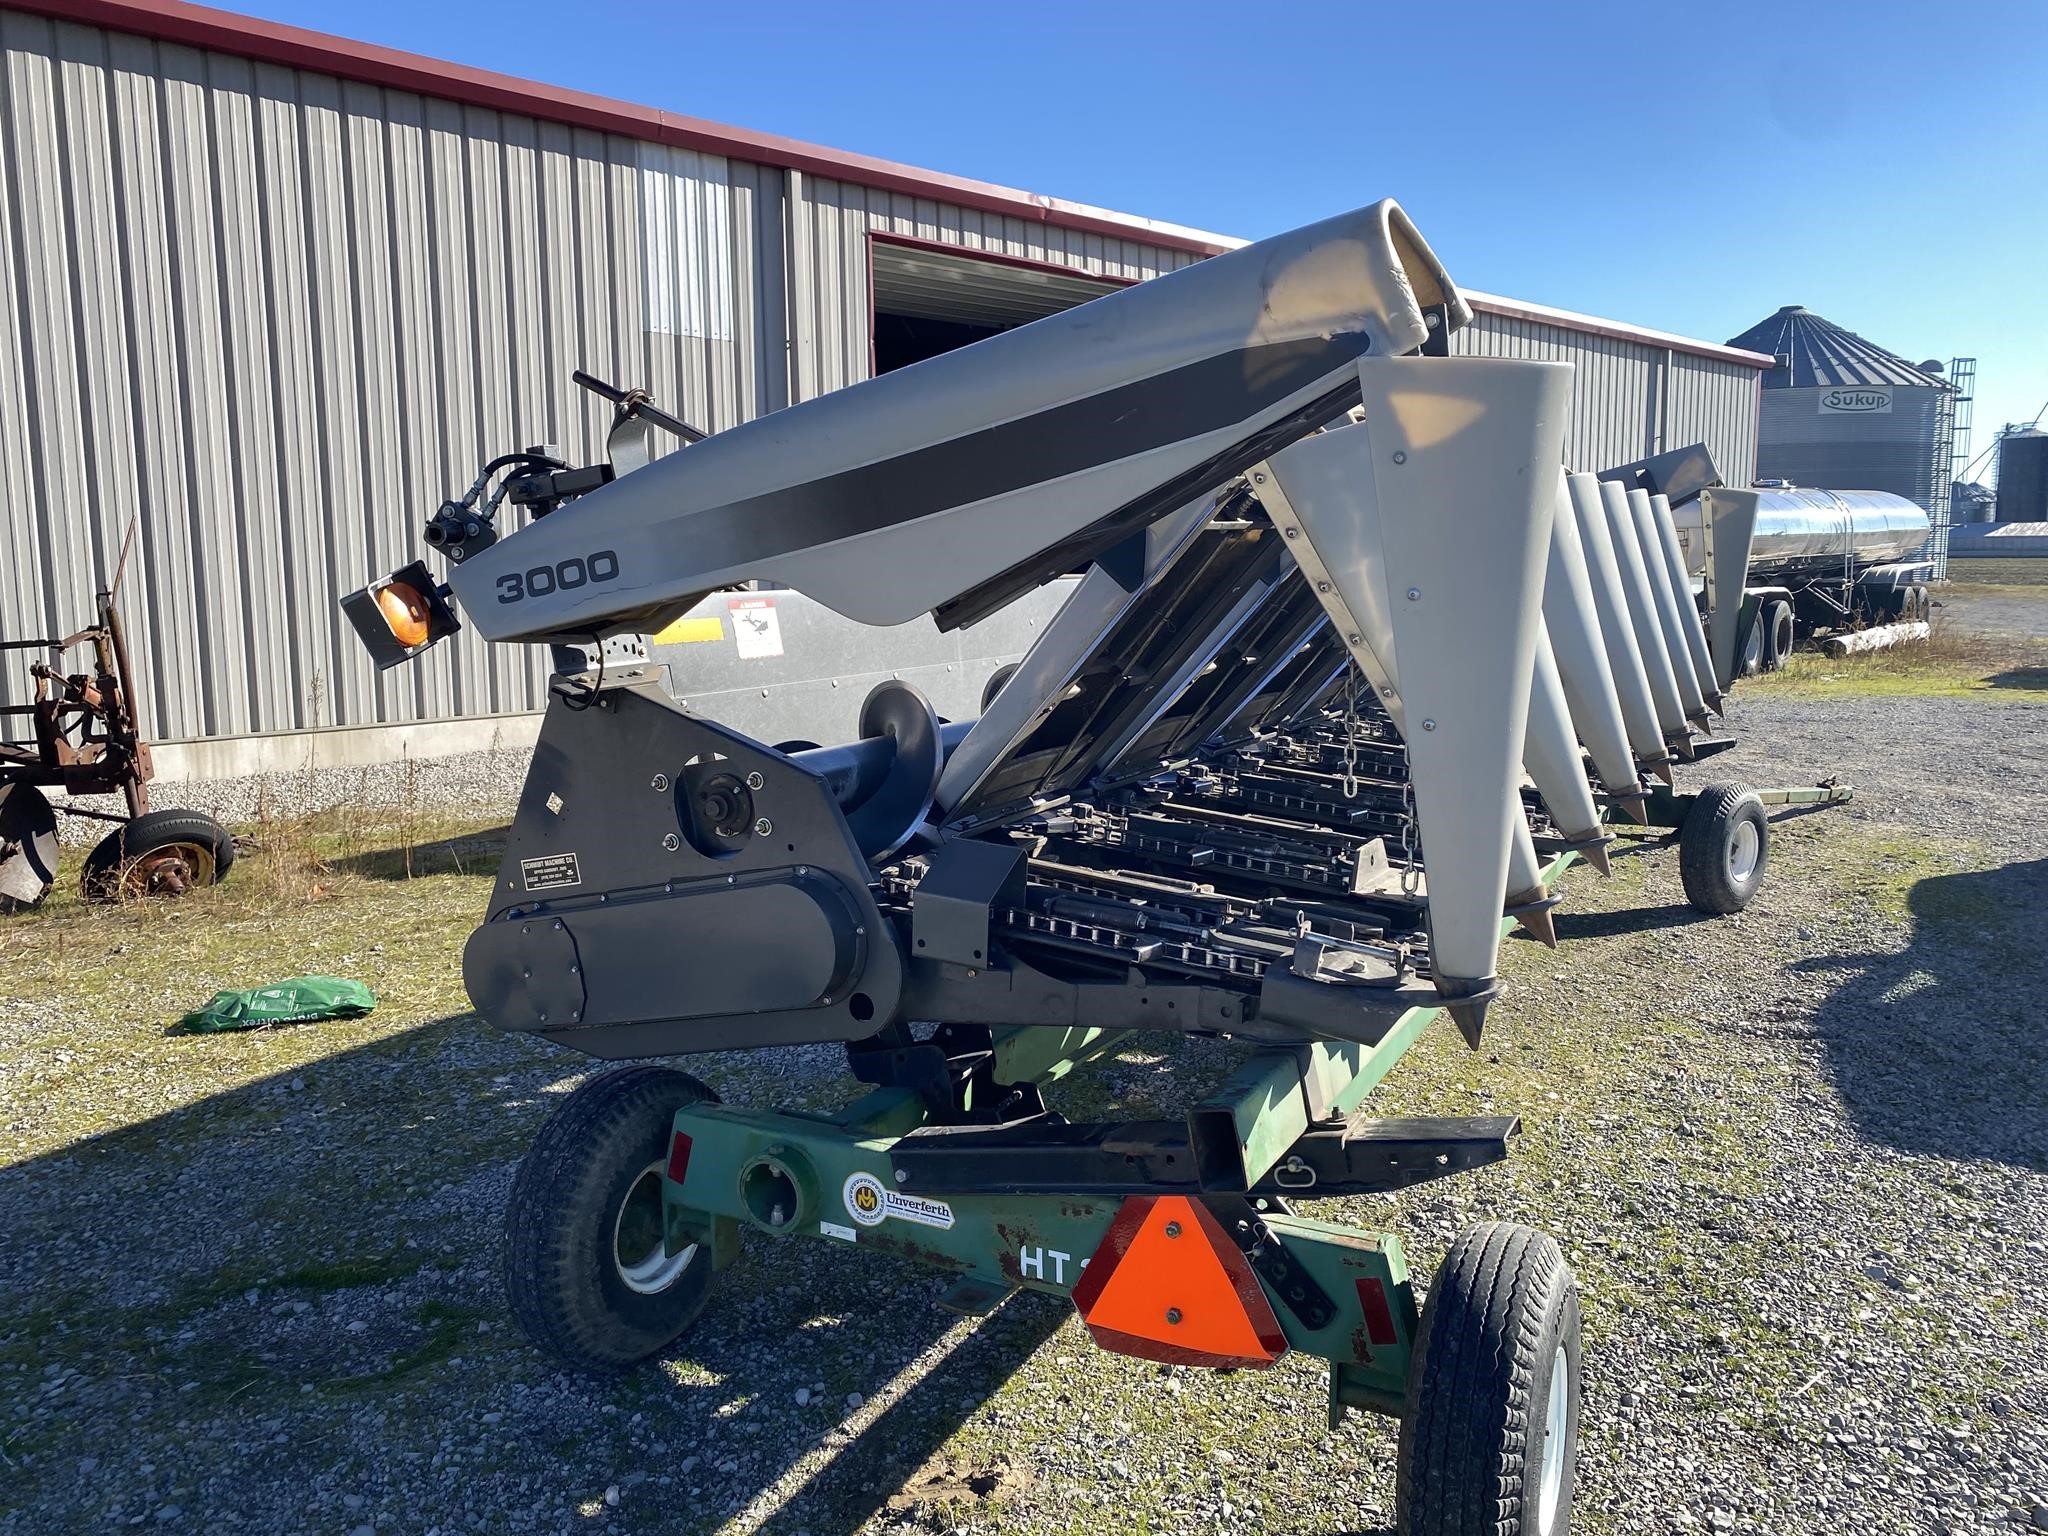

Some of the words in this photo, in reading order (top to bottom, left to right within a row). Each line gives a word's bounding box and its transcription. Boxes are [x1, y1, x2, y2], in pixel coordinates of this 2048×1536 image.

[1830, 391, 1885, 408] Sukup
[496, 550, 619, 604] 3000
[886, 1192, 950, 1218] Unverferth
[1020, 1245, 1071, 1284] HT
